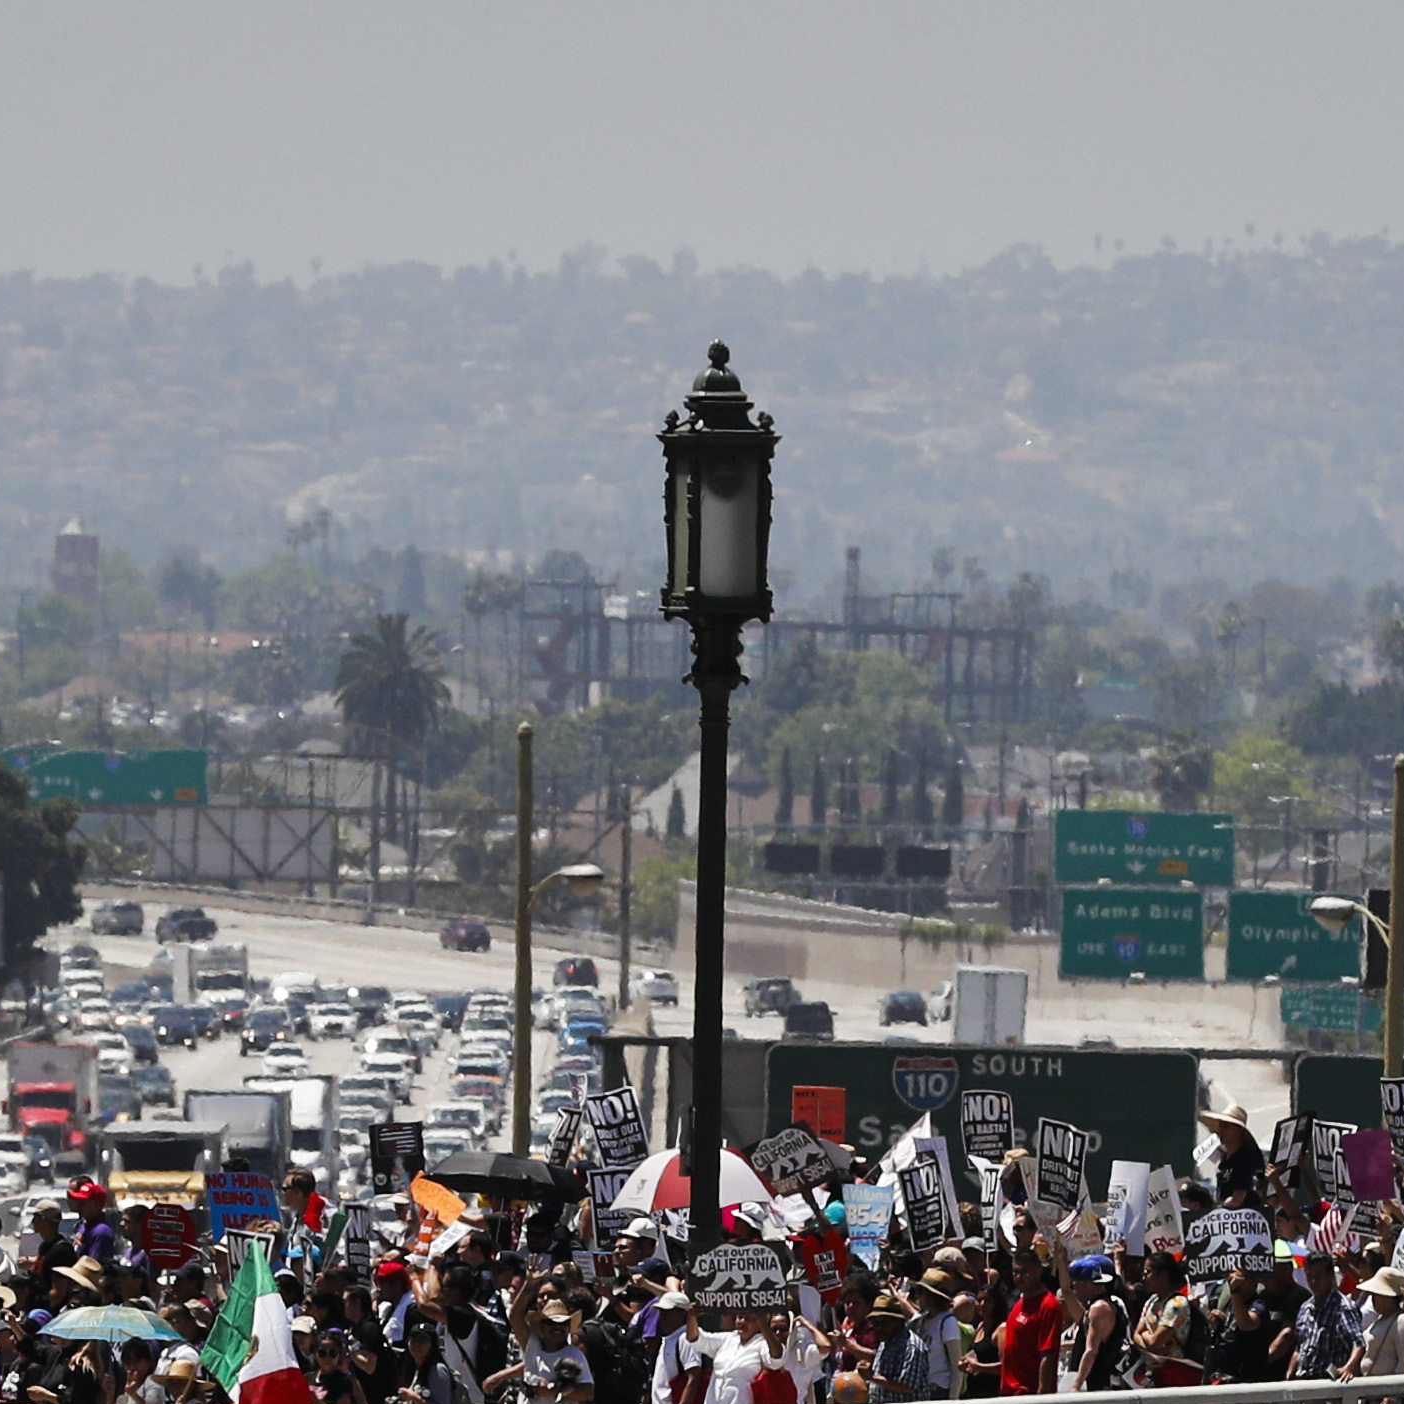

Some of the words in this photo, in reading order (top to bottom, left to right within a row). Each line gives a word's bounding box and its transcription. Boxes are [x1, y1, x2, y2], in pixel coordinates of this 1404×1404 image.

[1075, 902, 1140, 918] Adams
[1148, 903, 1194, 919] Blvd
[971, 1053, 1063, 1077] SOUTH
[904, 1072, 948, 1098] 110
[587, 1091, 637, 1126] NO!
[964, 1094, 1009, 1122] ¡NO!
[206, 1174, 227, 1188] NO
[213, 1191, 255, 1206] BEING
[1207, 1213, 1221, 1222] ICE
[1223, 1212, 1243, 1222] OUT
[1245, 1212, 1258, 1221] OF
[1191, 1220, 1269, 1239] CALIFORNIA
[713, 1249, 729, 1259] ICE
[731, 1249, 751, 1258] OUT
[752, 1248, 765, 1257] OF
[698, 1257, 779, 1273] CALIFORNIA
[1188, 1254, 1243, 1276] SUPPORT
[1245, 1253, 1275, 1272] SB54!
[694, 1291, 748, 1309] SUPPORT
[751, 1291, 787, 1308] SB54!
